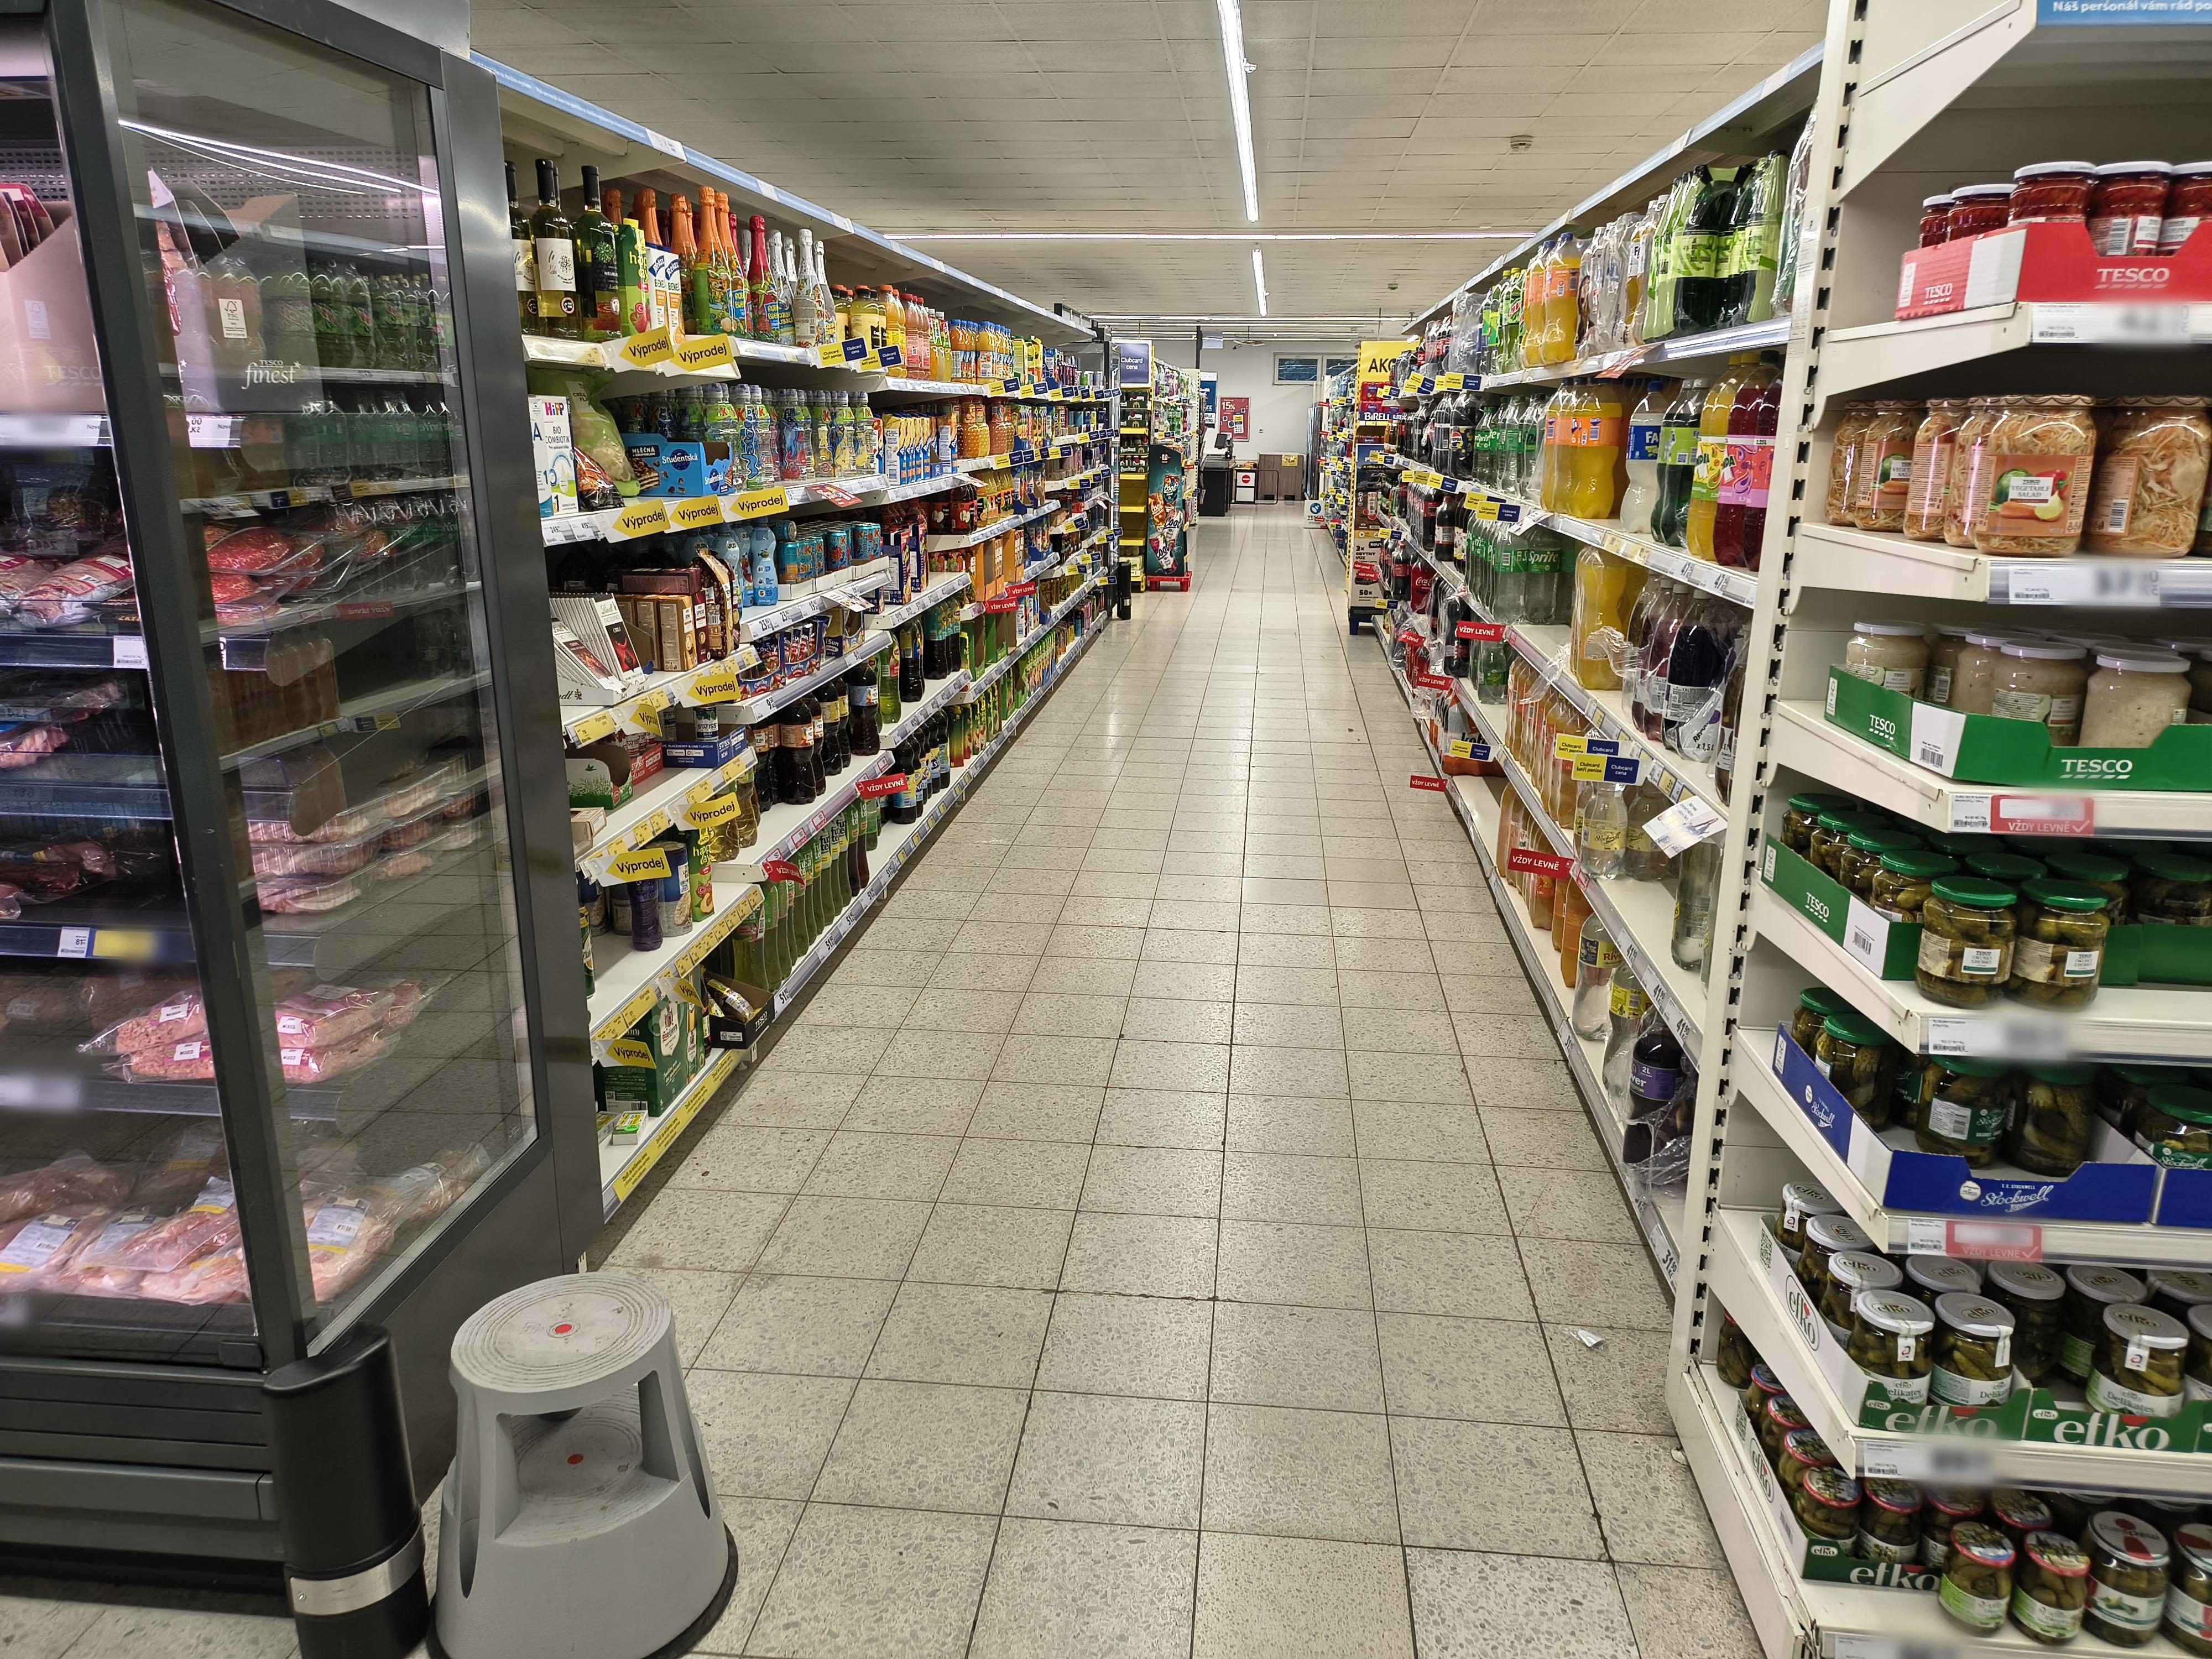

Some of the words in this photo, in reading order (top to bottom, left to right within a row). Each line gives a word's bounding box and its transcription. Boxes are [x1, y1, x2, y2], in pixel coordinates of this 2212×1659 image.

[2096, 267, 2171, 283] TESCO
[1925, 283, 1953, 298] TESCO
[628, 336, 670, 359] Výprodej
[679, 342, 728, 364] Výprodej
[1368, 358, 1396, 373] AKC
[241, 362, 296, 389] finest
[544, 401, 565, 416] HiPP
[1222, 401, 1236, 411] 15%
[661, 453, 698, 464] Studentská
[738, 494, 784, 511] Výprodej
[622, 508, 666, 529] Výprodej
[677, 503, 719, 521] Výprodej
[1528, 551, 1559, 564] Sprite
[1459, 625, 1474, 634] VŽDY
[1475, 628, 1495, 637] LEVNĚ
[695, 680, 735, 697] Výprodej
[1869, 714, 1896, 735] TESCO
[2061, 759, 2133, 774] TESCO
[867, 783, 883, 792] VŽDY
[884, 778, 905, 790] LEVNĚ
[690, 801, 736, 822] Výprodej
[2008, 820, 2035, 832] VŽDY
[2037, 821, 2070, 833] LEVNĚ
[616, 857, 665, 875] Výprodej
[1512, 854, 1532, 865] VŽDY
[1533, 858, 1560, 871] LEVNĚ
[1806, 892, 1830, 918] TESCO
[755, 1011, 768, 1028] TESCO
[613, 1047, 651, 1062] Výprodej
[1641, 1066, 1651, 1075] 2L
[1811, 1101, 1835, 1125] Stockwell
[1980, 1185, 2054, 1207] Stockwell
[1961, 1245, 1986, 1257] VŽDY
[1991, 1246, 2020, 1259] LEVNĚ
[1788, 1291, 1815, 1344] efko
[1888, 1388, 1921, 1397] elikates
[1885, 1406, 1997, 1437] efko
[2053, 1412, 2170, 1451] efko
[1813, 1546, 1835, 1556] efko
[1850, 1562, 1941, 1591] efko
